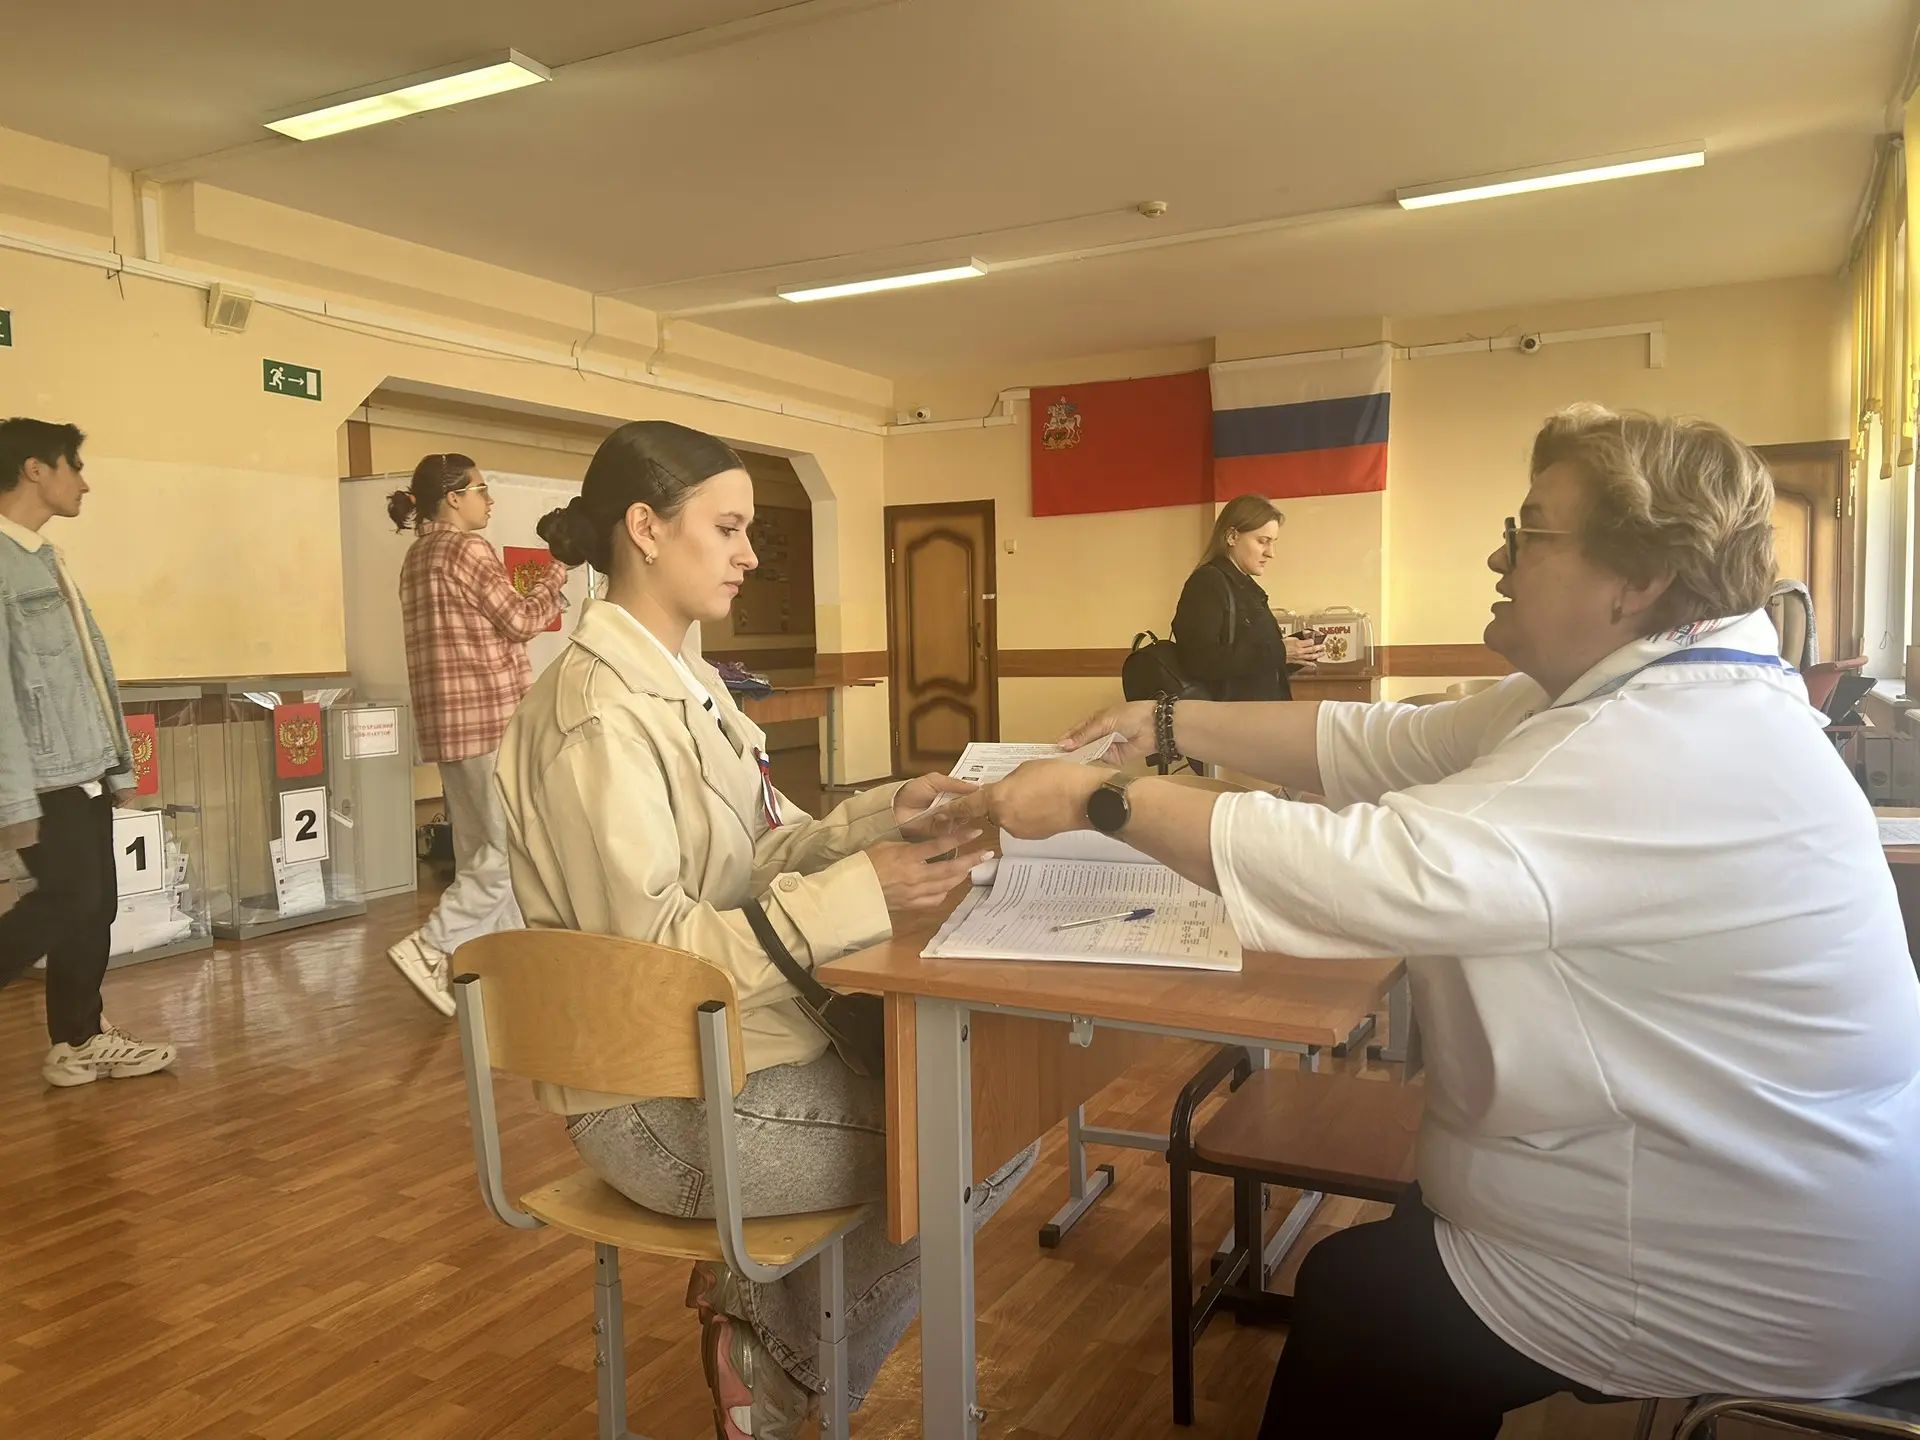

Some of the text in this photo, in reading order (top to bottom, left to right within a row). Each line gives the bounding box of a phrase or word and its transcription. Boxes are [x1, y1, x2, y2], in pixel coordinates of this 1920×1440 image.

[1318, 626, 1351, 635] ВЫБОРЫ
[295, 809, 317, 841] 2
[126, 836, 146, 871] 1
